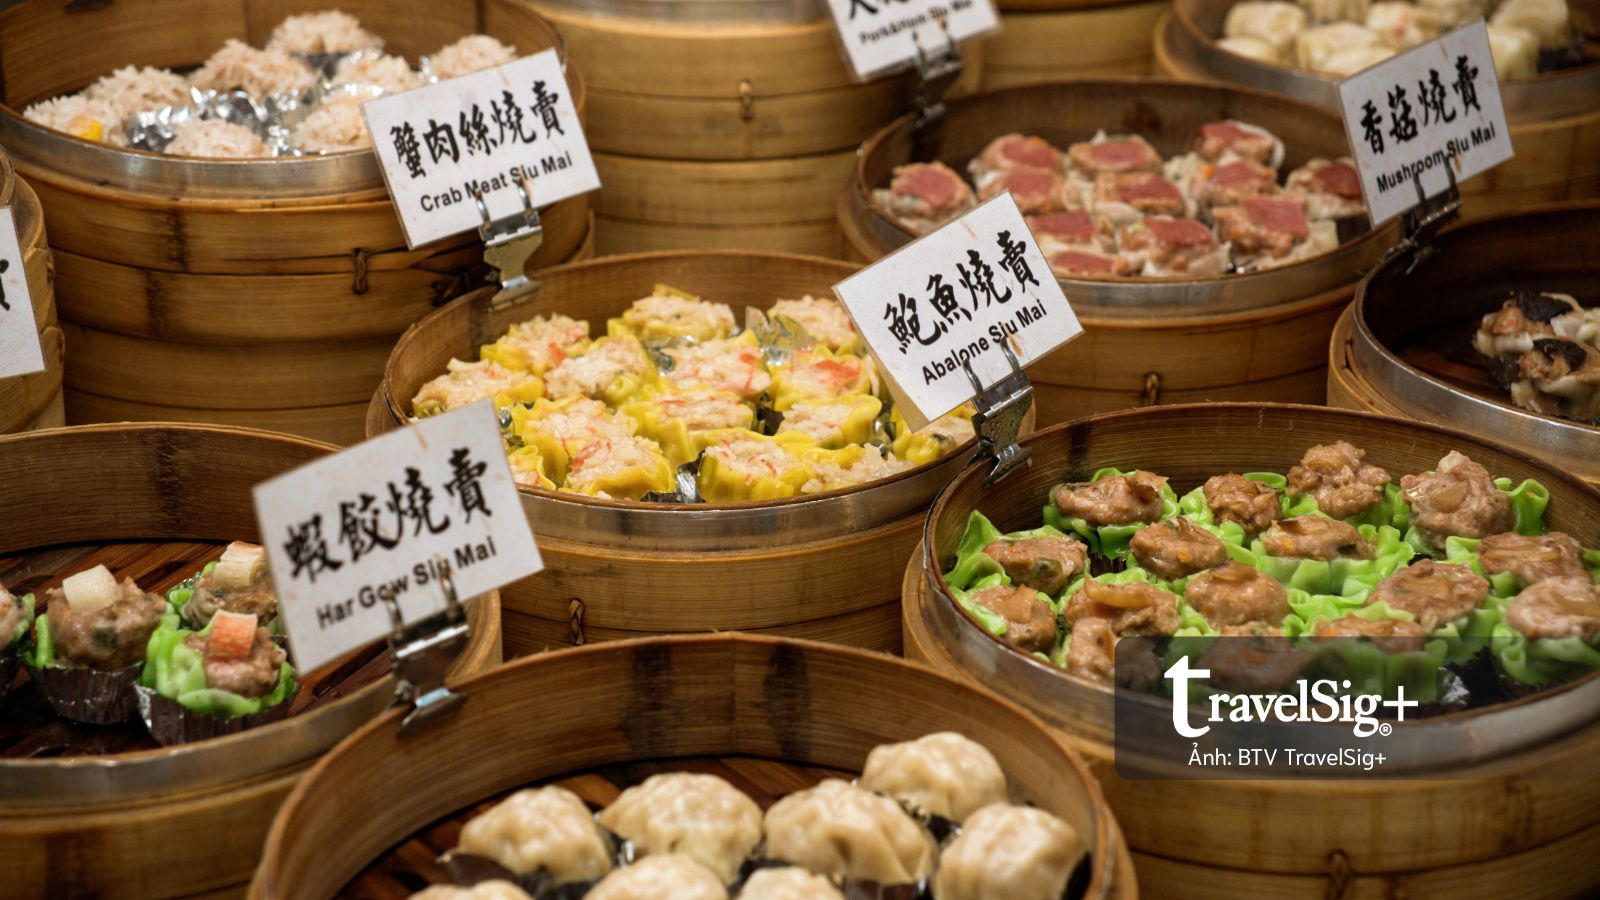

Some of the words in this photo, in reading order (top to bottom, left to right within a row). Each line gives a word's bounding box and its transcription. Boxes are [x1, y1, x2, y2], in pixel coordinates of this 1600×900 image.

[389, 80, 566, 179] 蟹肉絲燒賣
[1360, 54, 1481, 155] 香菇燒賣
[420, 185, 463, 212] Crab
[464, 174, 509, 200] Meat
[509, 165, 539, 186] Siu
[540, 150, 573, 174] Mai
[1376, 150, 1446, 194] Mushroom
[1446, 135, 1470, 158] Siu
[1470, 121, 1496, 148] Mai
[883, 230, 1040, 355] 鮑魚燒賣
[922, 337, 990, 386] Abalone
[988, 322, 1019, 344] Siu
[1015, 299, 1048, 330] Mai
[283, 447, 492, 584] 蝦餃燒賣
[316, 597, 354, 630] Har
[358, 574, 409, 608] Gow
[412, 558, 451, 587] Siu
[455, 536, 498, 570] Mai
